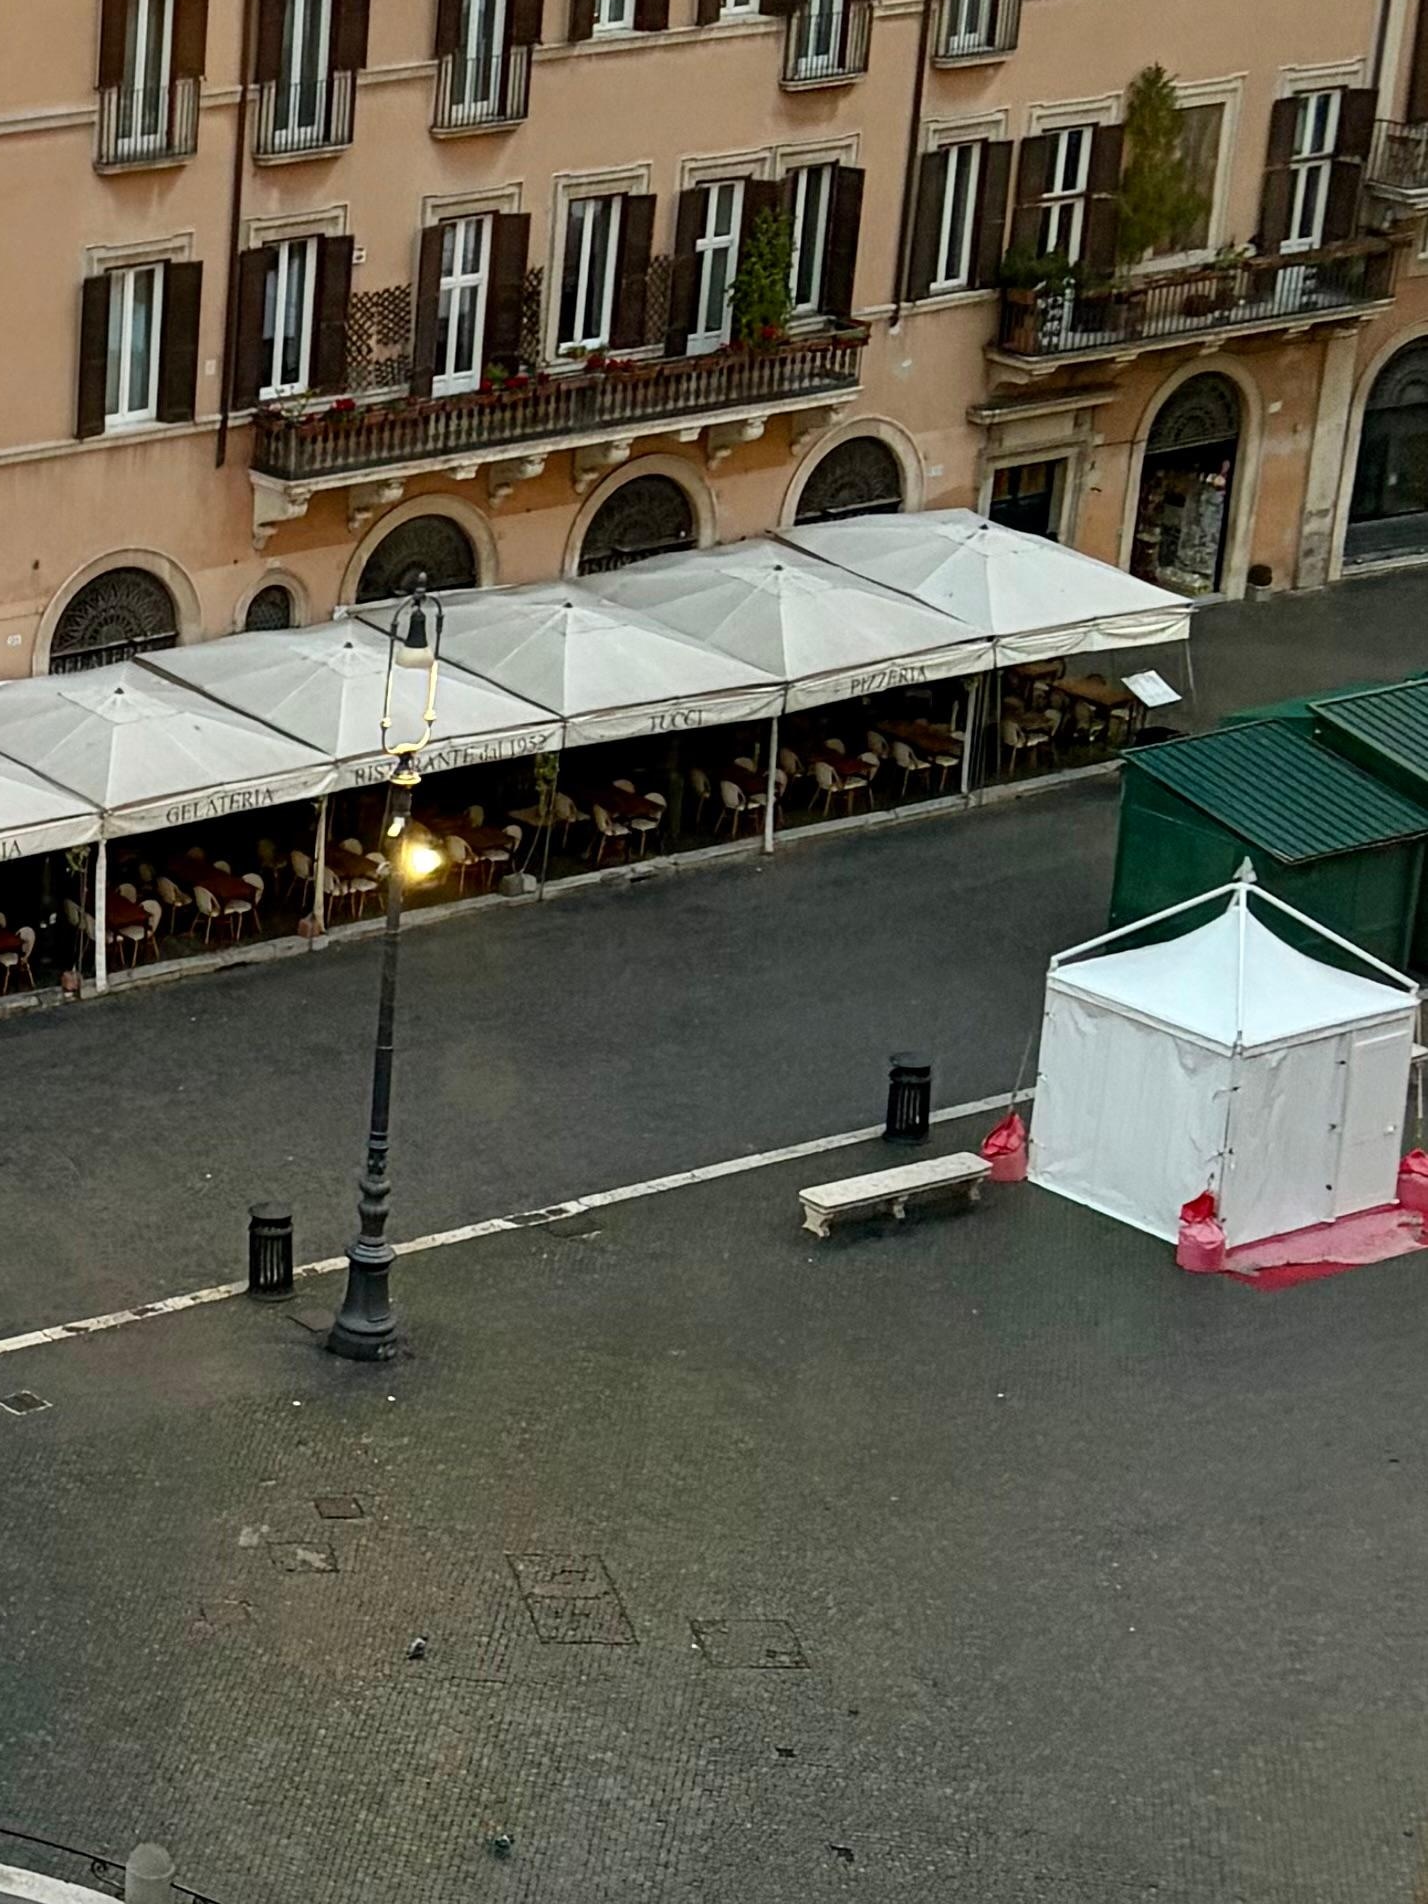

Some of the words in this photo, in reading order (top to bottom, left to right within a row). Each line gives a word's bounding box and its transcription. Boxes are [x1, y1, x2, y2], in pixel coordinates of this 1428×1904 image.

[850, 666, 927, 695] PIZZERIA
[648, 709, 703, 732] TUCCI
[355, 746, 475, 785] RISTRANTE
[166, 788, 274, 824] GELATERIA
